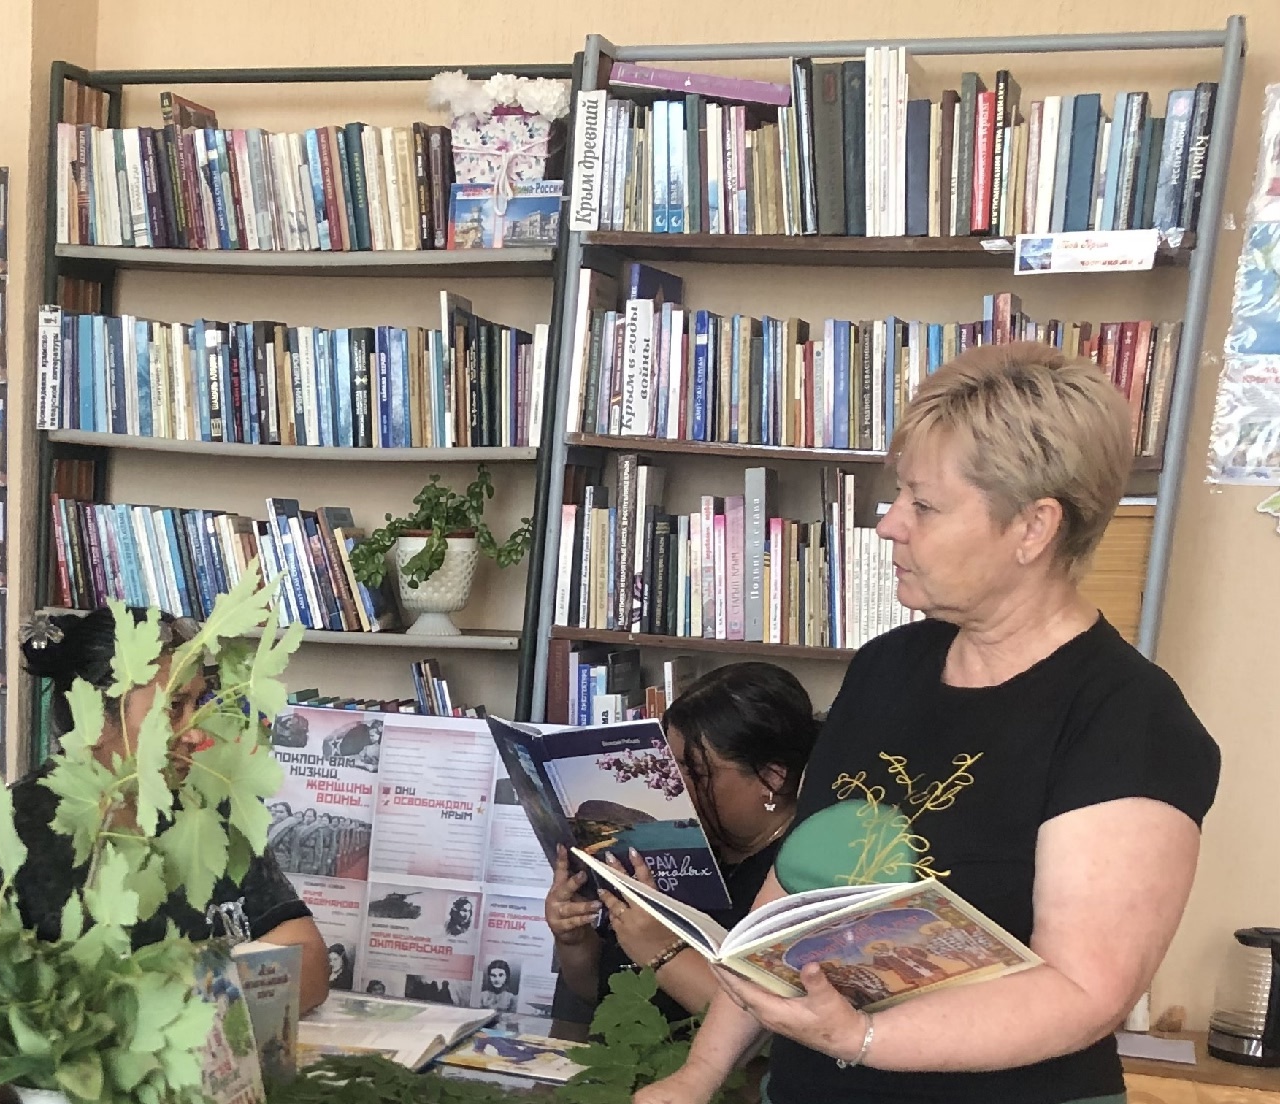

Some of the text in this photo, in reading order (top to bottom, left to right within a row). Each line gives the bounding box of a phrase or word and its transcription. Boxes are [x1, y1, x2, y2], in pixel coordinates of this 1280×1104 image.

[575, 99, 599, 224] Крым древний
[1189, 135, 1209, 179] Крым
[49, 333, 59, 426] татарской литературы
[621, 306, 638, 430] Крым в годы
[639, 337, 650, 399] войны
[292, 352, 303, 413] ЭРВИН УМЕРОВ
[38, 372, 47, 428] Произведения
[731, 552, 740, 614] СТАРЫЙ КРЫМ
[618, 588, 626, 625] ПАМЯТНИКИ
[274, 751, 356, 768] ПОКЛОН ВАМ
[306, 779, 373, 795] ЖЕНЩИНЫ
[394, 786, 416, 796] ОНИ
[393, 797, 474, 811] ОСВОБОЖДАЛИ
[441, 810, 473, 821] КРЫМ
[645, 853, 678, 870] РАЙ
[657, 877, 679, 892] ОР
[487, 919, 526, 932] БЕЛИК
[370, 938, 453, 956] ОКТЯБРЬСКАЯ
